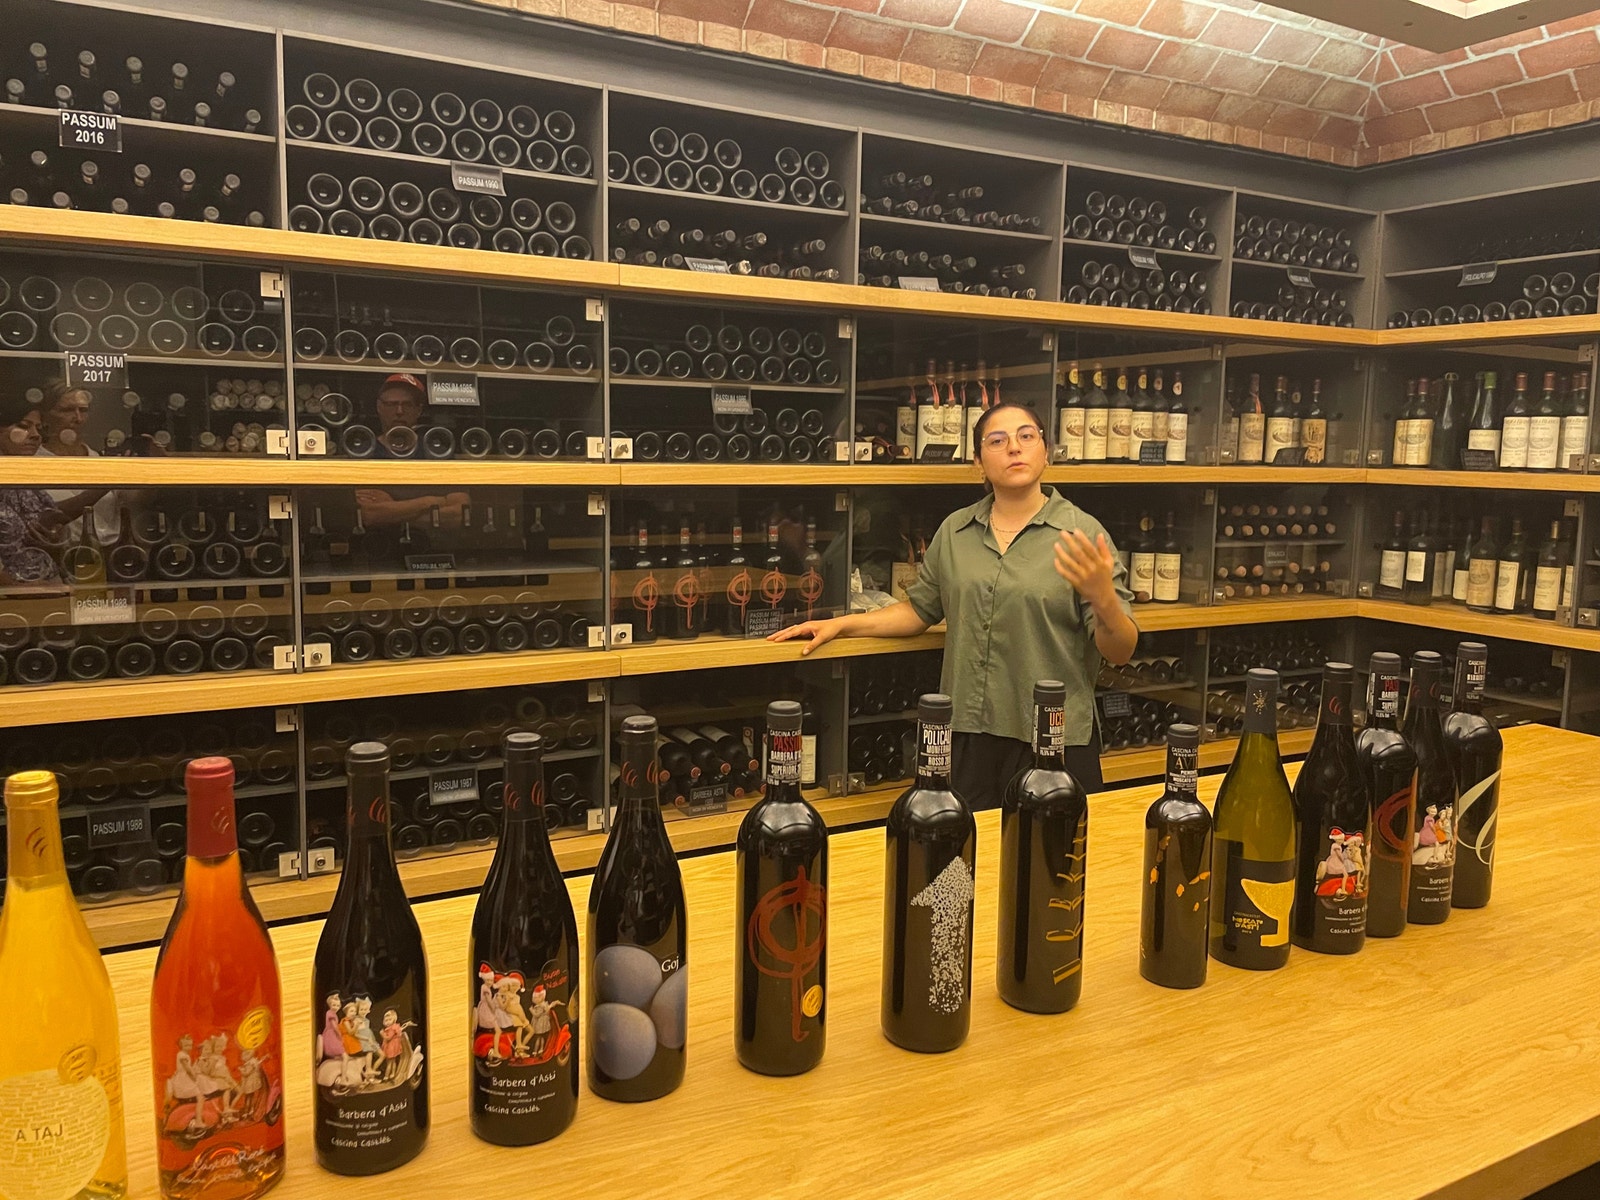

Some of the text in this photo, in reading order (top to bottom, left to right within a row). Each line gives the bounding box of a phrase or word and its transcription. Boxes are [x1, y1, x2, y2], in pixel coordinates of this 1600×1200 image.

[62, 112, 117, 130] PASSUM
[75, 129, 105, 145] 2016
[458, 176, 485, 187] PASSUM
[69, 354, 124, 368] PASSUM
[83, 369, 111, 383] 2017
[432, 382, 458, 393] PASSUM
[76, 598, 109, 610] PASSUM
[769, 729, 791, 737] CASCINA
[770, 750, 794, 761] BARBERA
[1171, 746, 1192, 754] CASCINA
[771, 764, 798, 775] SUPERIORE
[434, 780, 459, 791] PASSUM
[93, 821, 125, 835] PASSUM
[1232, 916, 1263, 924] MOSCATO
[661, 956, 679, 972] Goj
[491, 1070, 556, 1088] Barbera d'Asti
[338, 1098, 407, 1119] Barbera d'Asti
[484, 1103, 510, 1114] Cascina
[16, 1124, 63, 1141] A TAJ
[331, 1137, 358, 1148] Cascina
